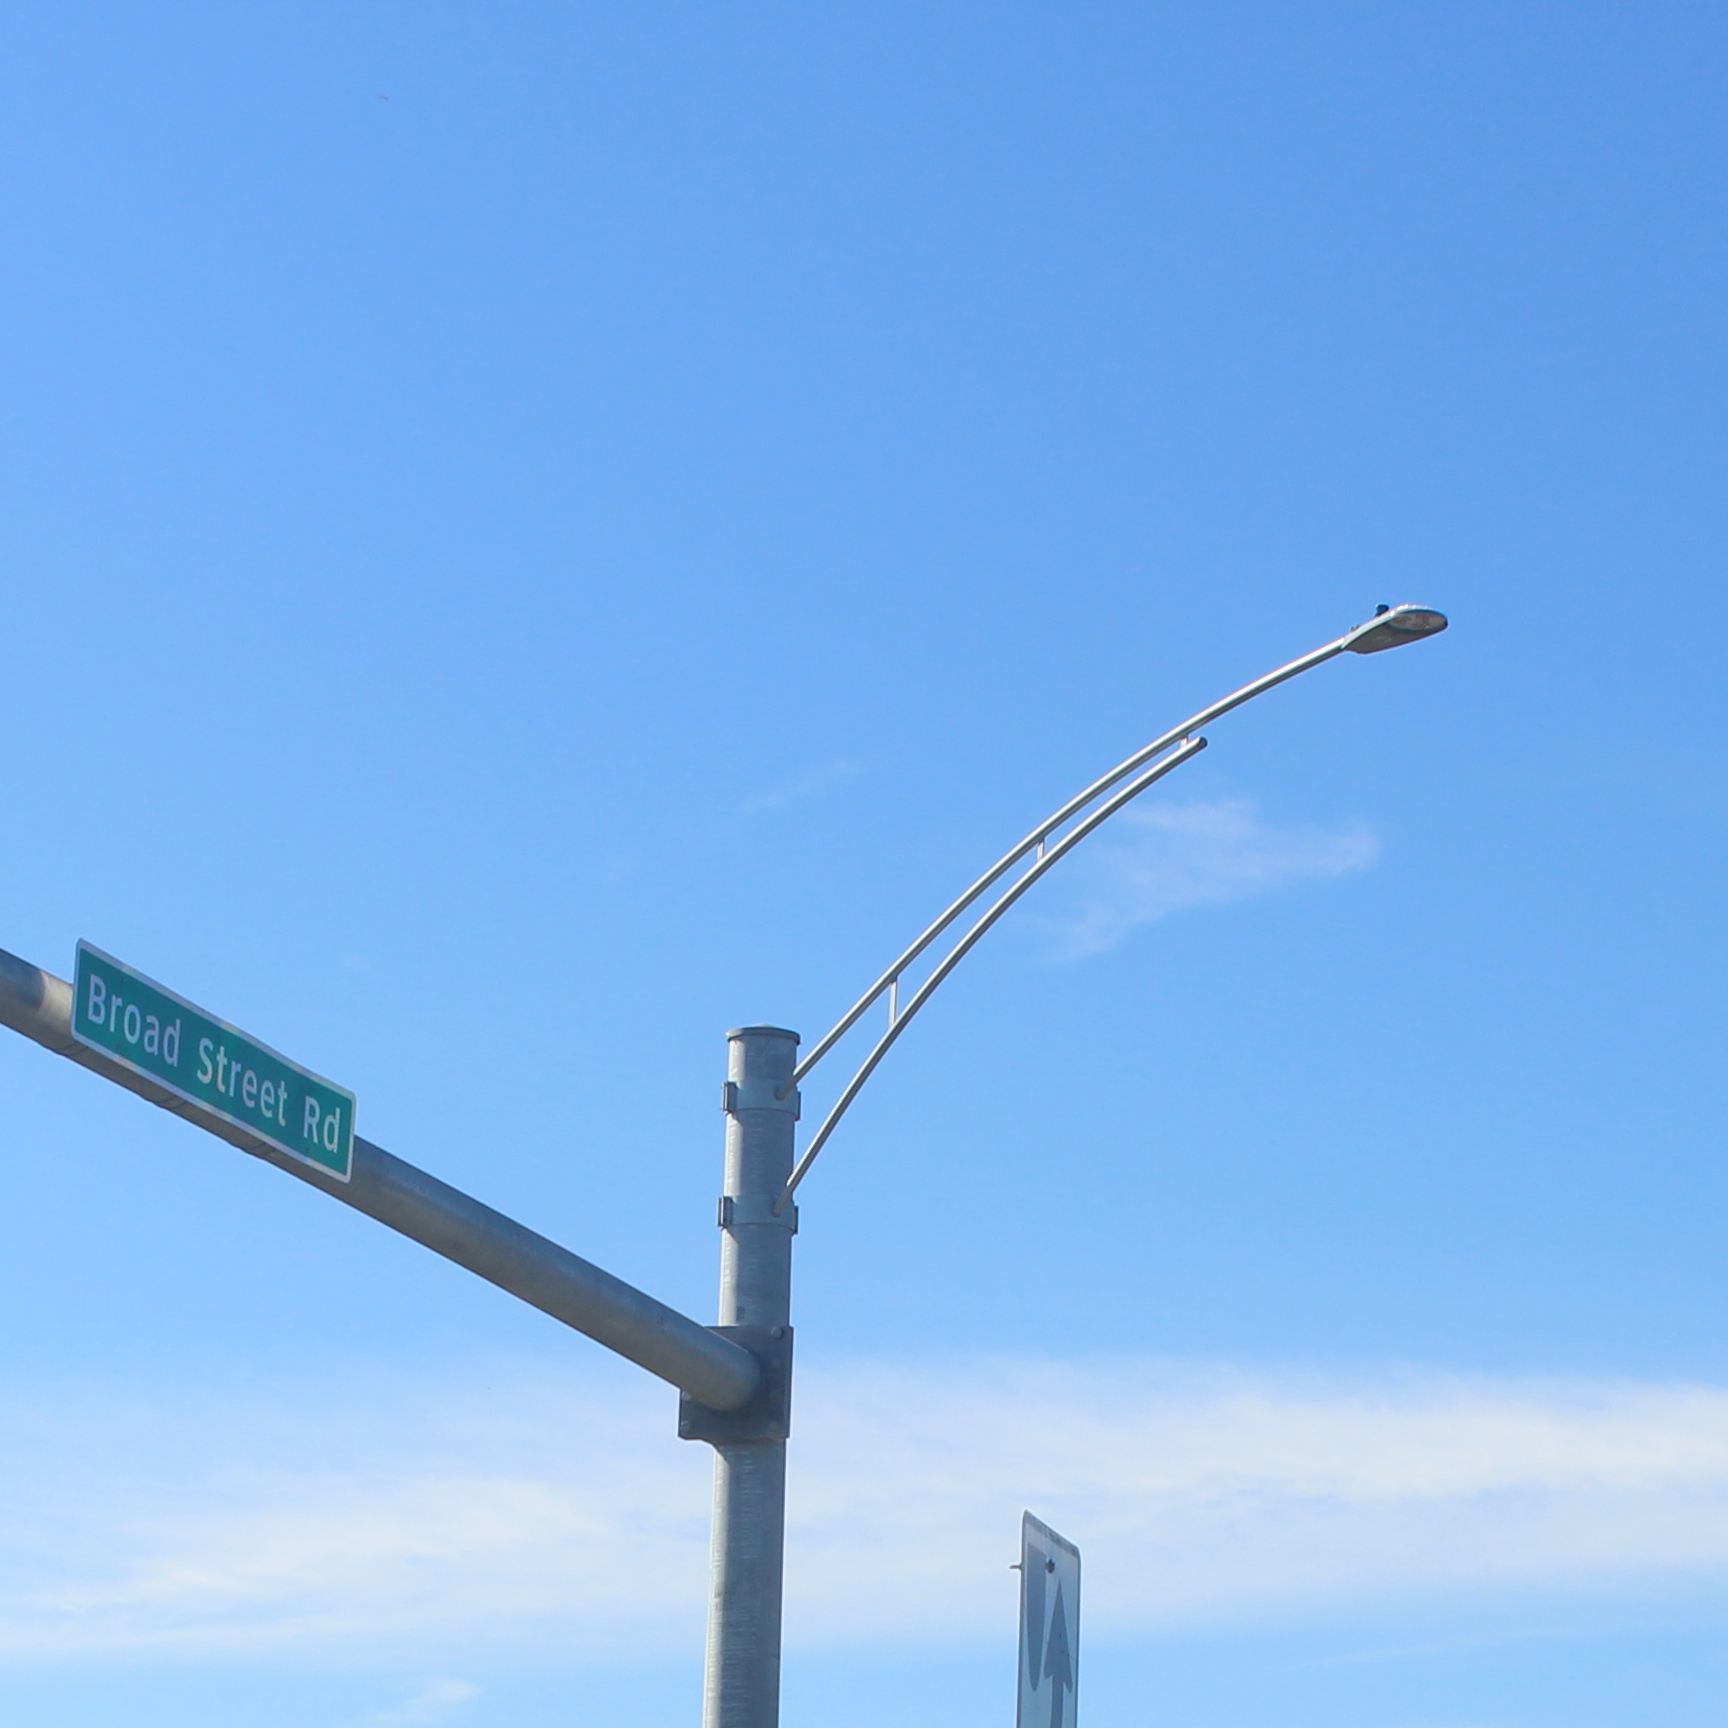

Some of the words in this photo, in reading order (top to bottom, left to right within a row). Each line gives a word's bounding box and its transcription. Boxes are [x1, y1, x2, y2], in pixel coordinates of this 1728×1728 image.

[87, 974, 181, 1067] Broad
[196, 1037, 288, 1127] Street
[303, 1095, 341, 1154] Rd
